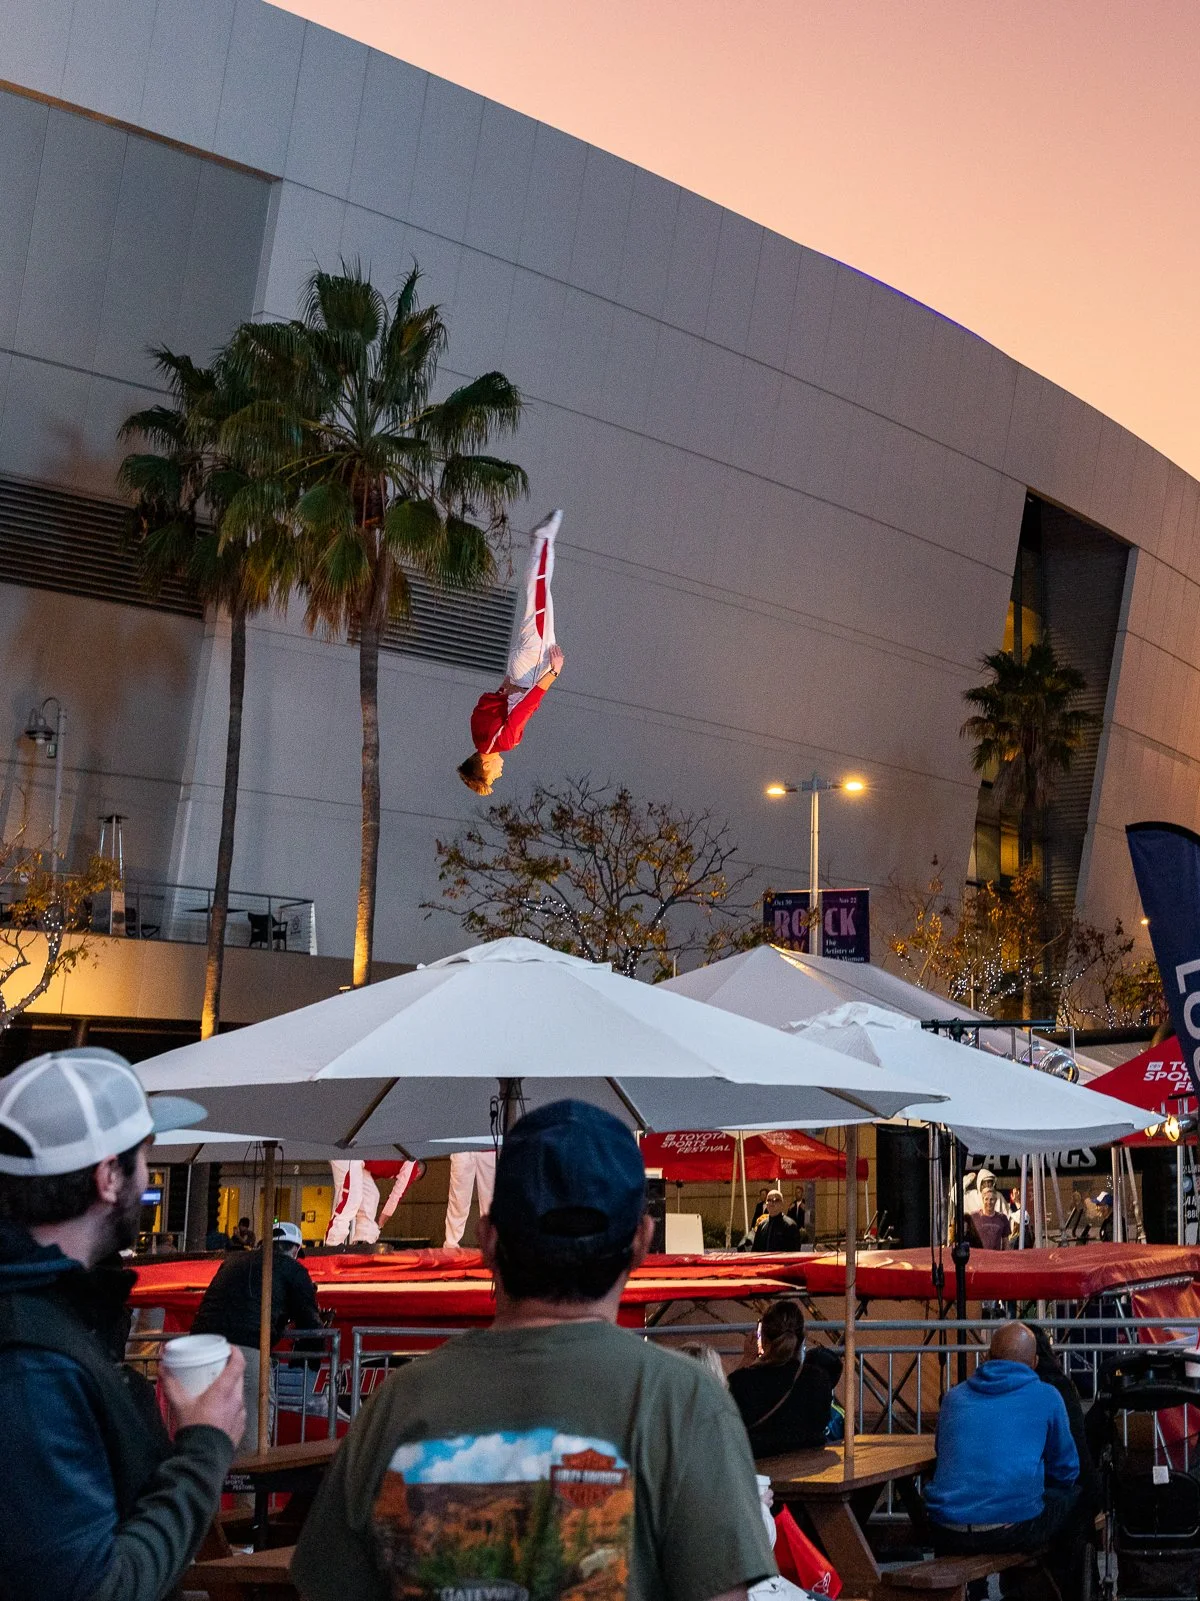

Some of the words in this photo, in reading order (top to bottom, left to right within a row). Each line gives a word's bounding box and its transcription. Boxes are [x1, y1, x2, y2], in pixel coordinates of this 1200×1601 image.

[679, 1132, 727, 1141] TOYOTA
[660, 1140, 708, 1148] SPORTS
[677, 1145, 731, 1154] FESTIVAL
[294, 1165, 300, 1174] 2
